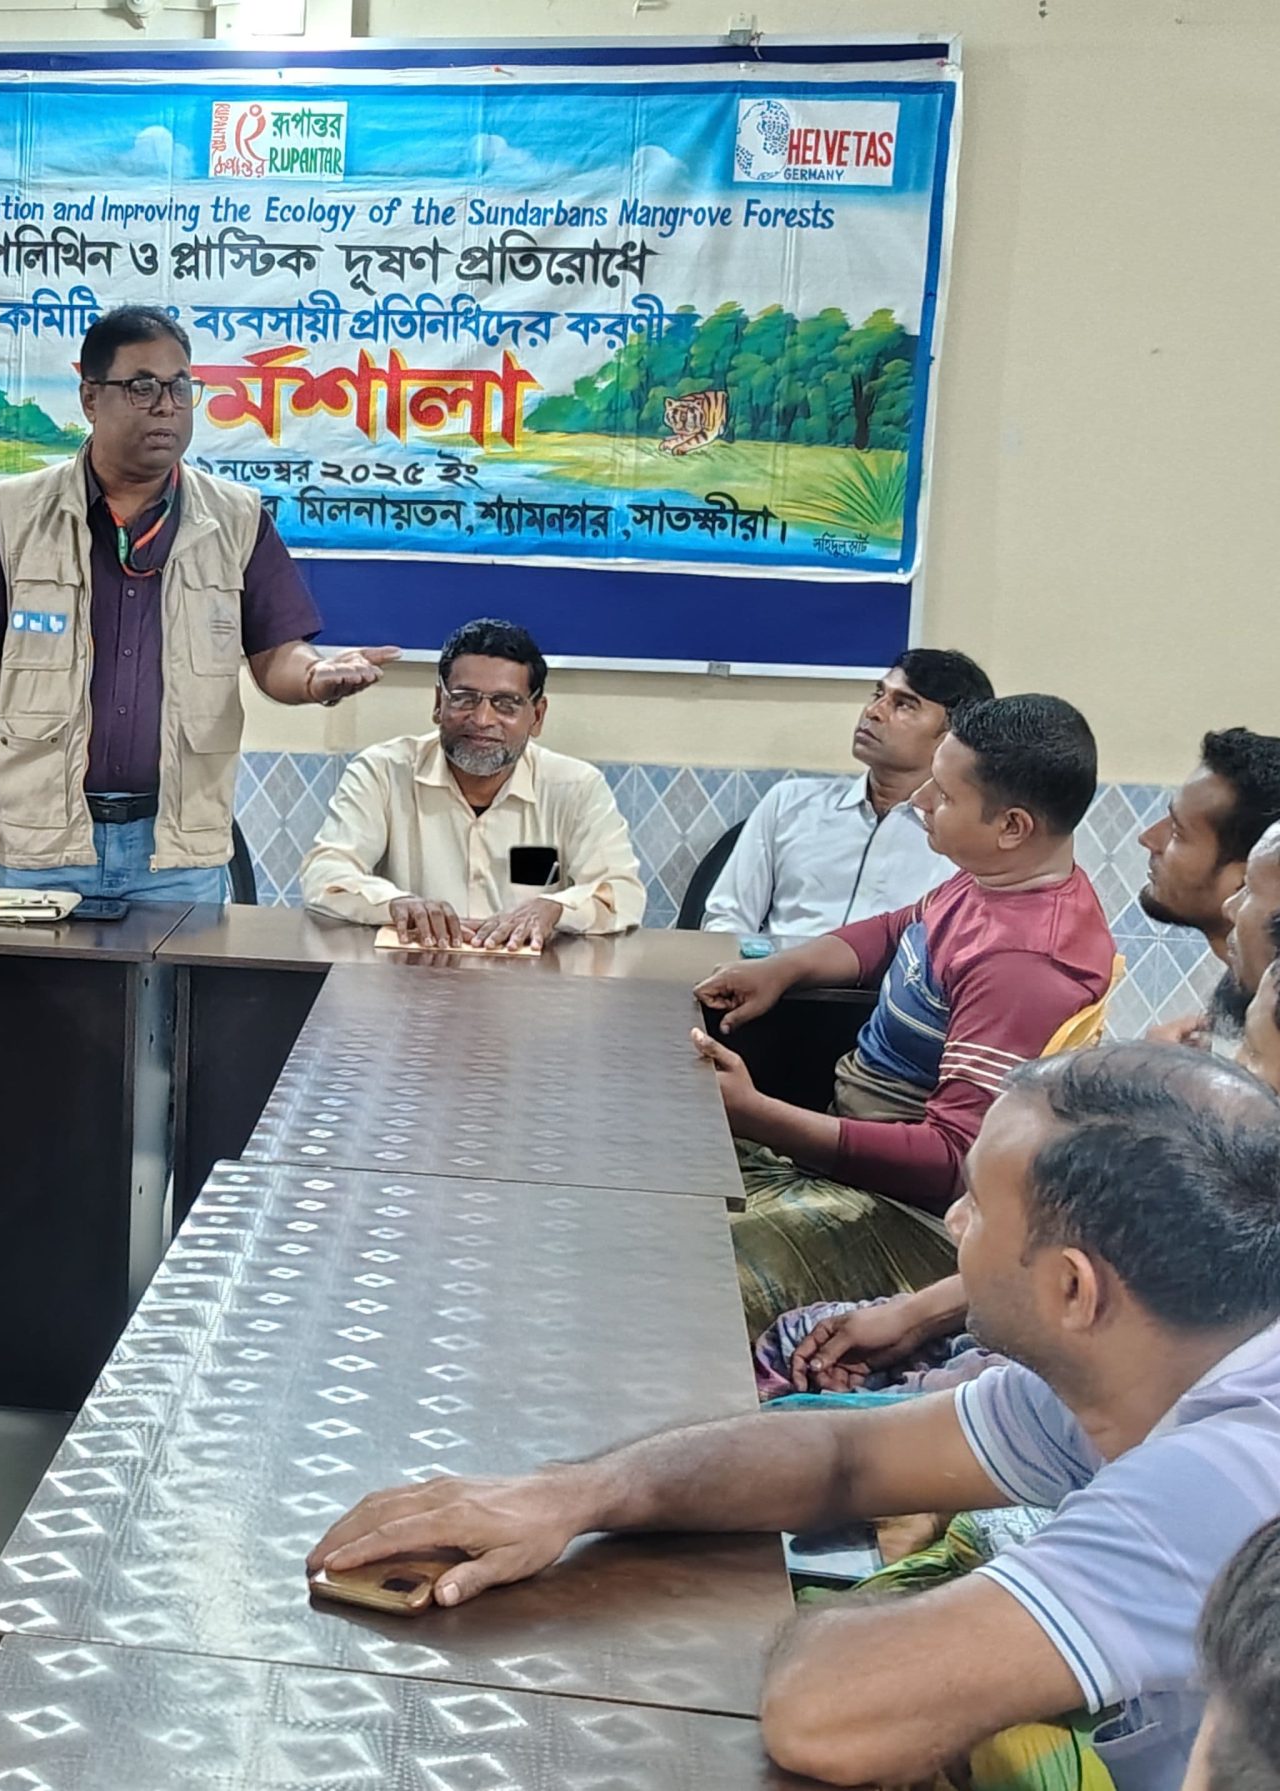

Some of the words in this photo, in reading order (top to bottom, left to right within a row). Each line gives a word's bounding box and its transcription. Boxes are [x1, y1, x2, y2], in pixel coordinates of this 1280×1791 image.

[271, 107, 344, 139] রূপান্তর
[269, 147, 343, 174] RUPANTAR
[787, 129, 893, 167] HELVETAS
[783, 168, 844, 180] GERMANY
[53, 195, 94, 221] and
[101, 195, 199, 233] Improving
[212, 195, 252, 222] the
[265, 196, 356, 233] Ecology
[369, 197, 402, 227] of
[411, 199, 457, 227] the
[468, 200, 608, 228] Sundarbans
[618, 200, 733, 238] Mangrove
[743, 200, 835, 229] Forests
[130, 235, 159, 276] ও
[170, 226, 326, 281] প্লাস্টিক
[335, 237, 450, 295] দূষণ
[456, 229, 659, 289] প্রতিরোধে
[191, 289, 351, 343] ব্যবসায়ী
[350, 292, 558, 347] প্রতিনিধিদের
[71, 345, 543, 448] র্মশালা
[215, 460, 313, 484] নভেম্বর
[320, 462, 425, 486] ২০২৫
[435, 450, 484, 489] ইং
